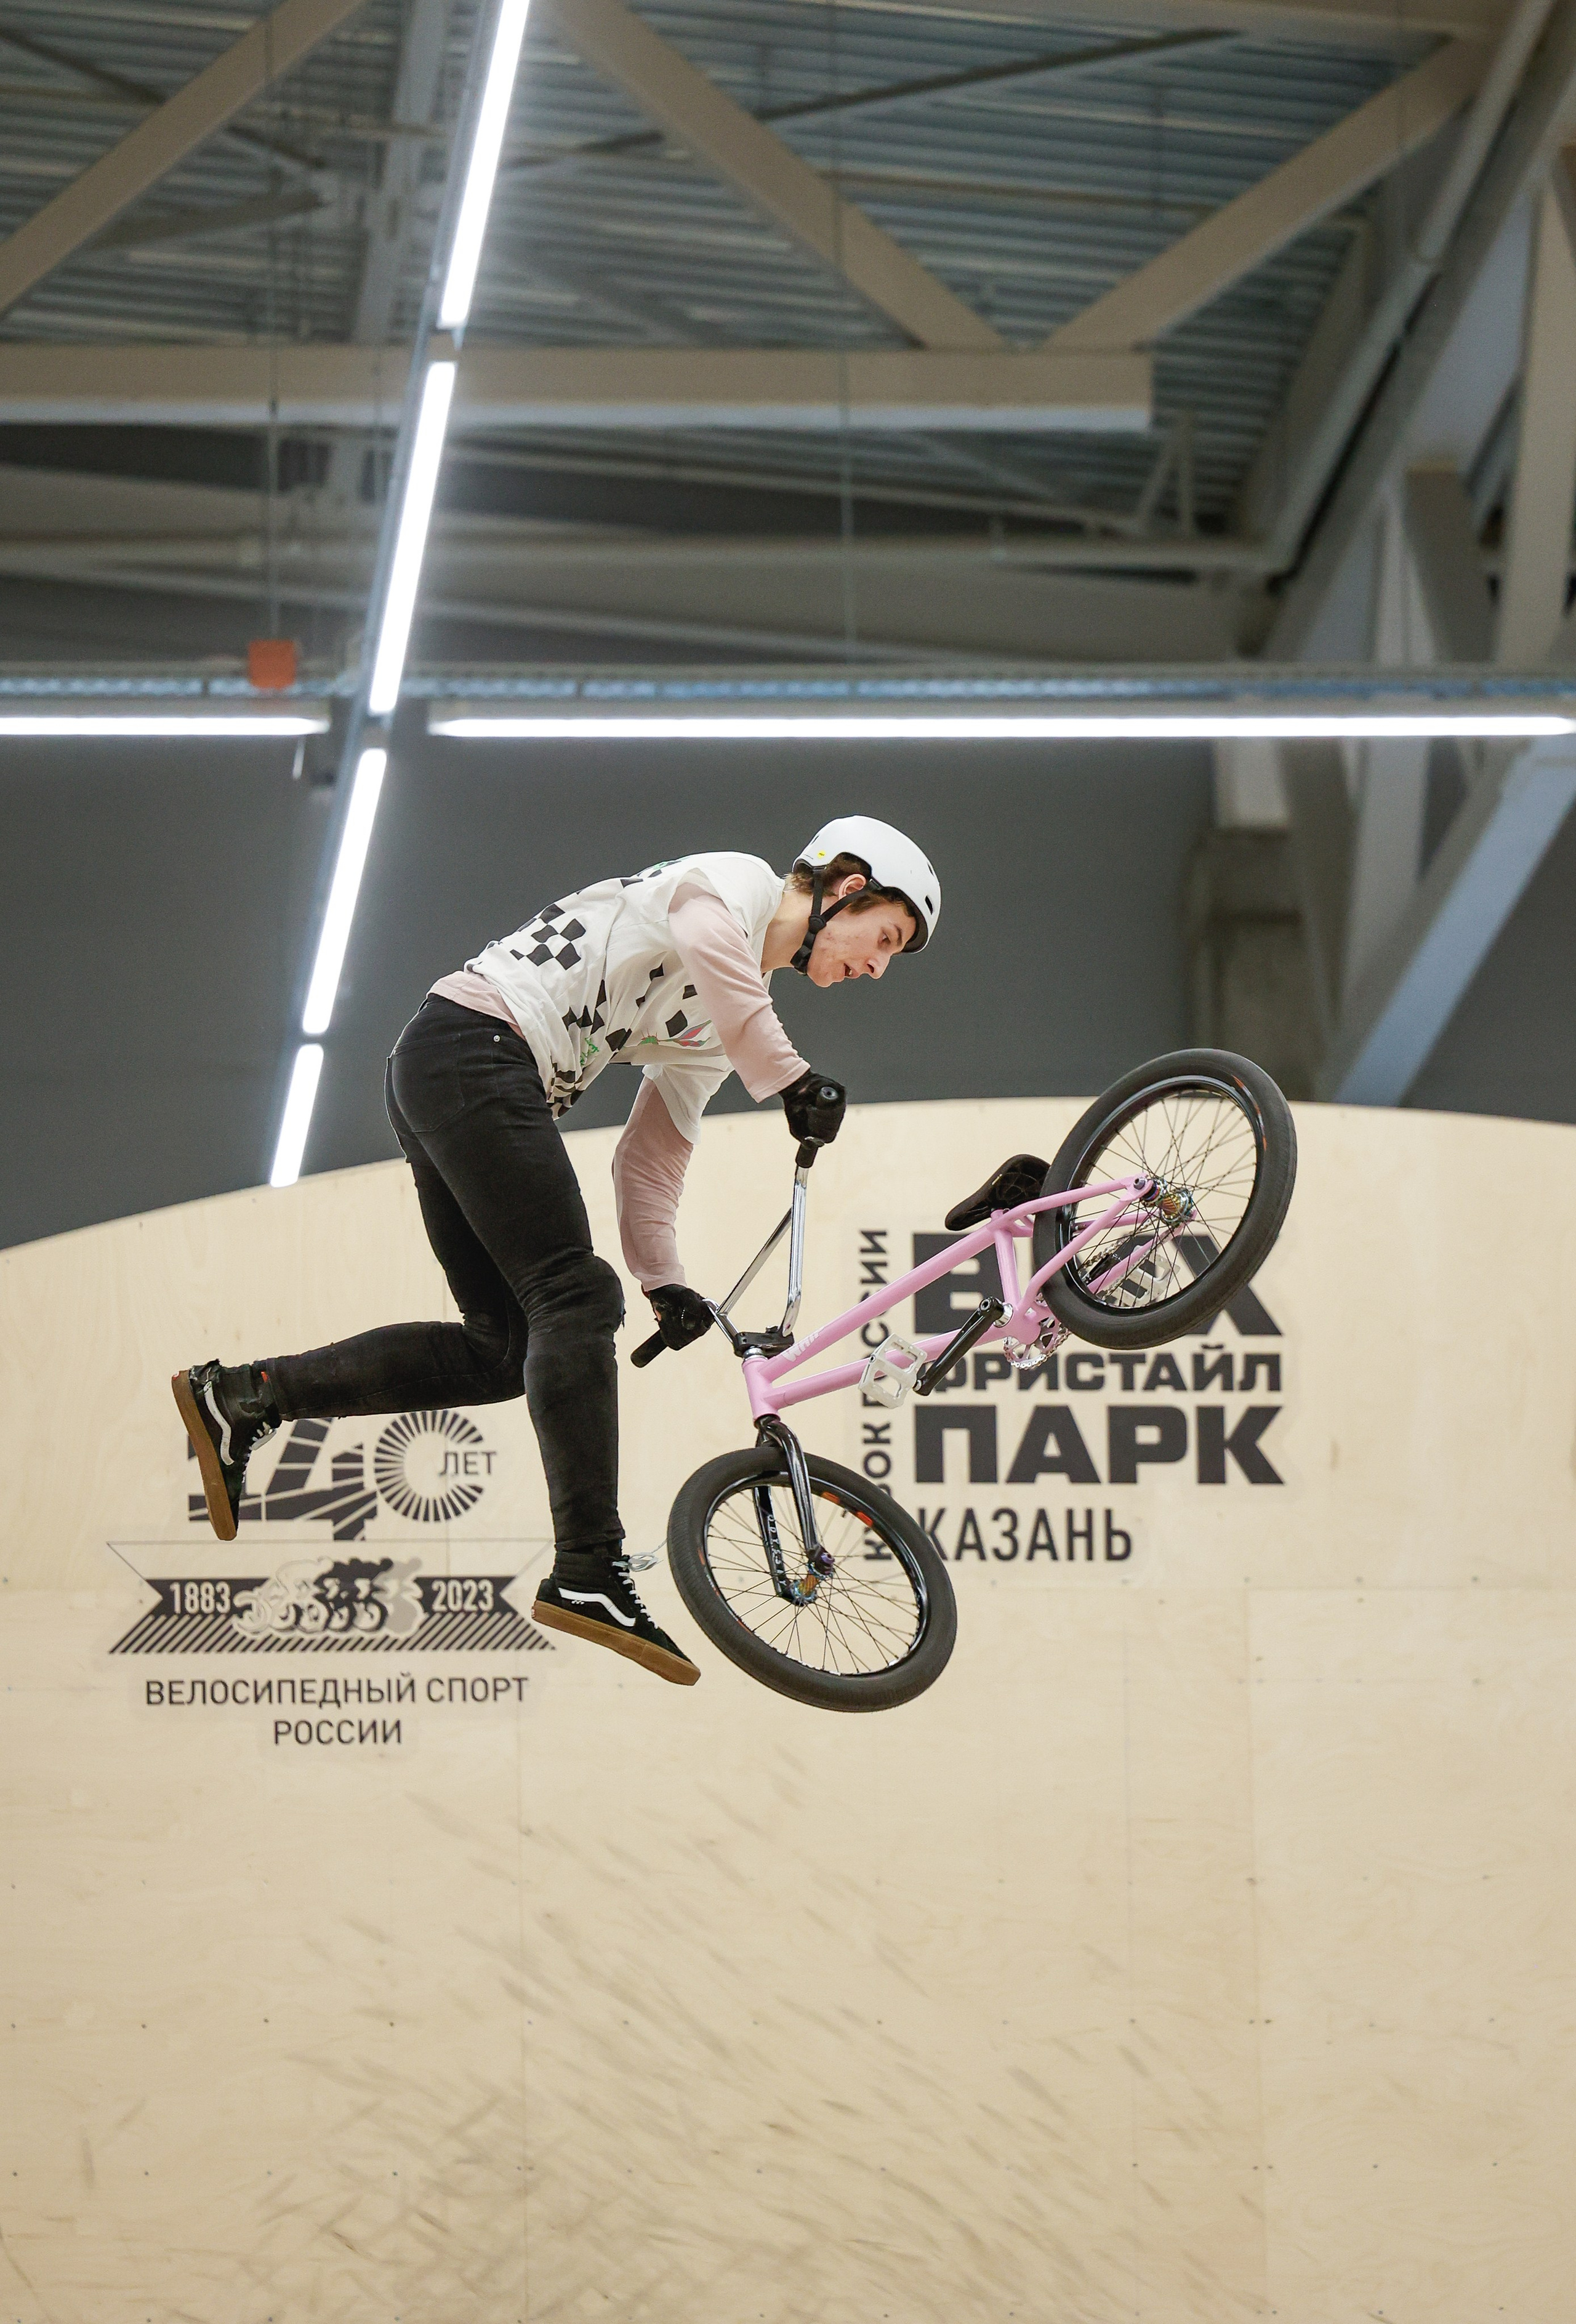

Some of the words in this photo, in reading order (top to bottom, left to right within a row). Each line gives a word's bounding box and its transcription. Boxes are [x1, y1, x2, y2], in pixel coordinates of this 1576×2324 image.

[914, 1404, 1285, 1485] ПАРК
[438, 1450, 497, 1477] ЛЕТ
[918, 1507, 1132, 1561] КАЗАНЬ
[169, 1581, 231, 1614] 1883
[431, 1579, 494, 1613] 2023
[145, 1671, 416, 1709] ВЕЛОСИПЕДНЫЙ
[427, 1677, 528, 1702] СПОРТ
[273, 1719, 401, 1745] РОССИИ
